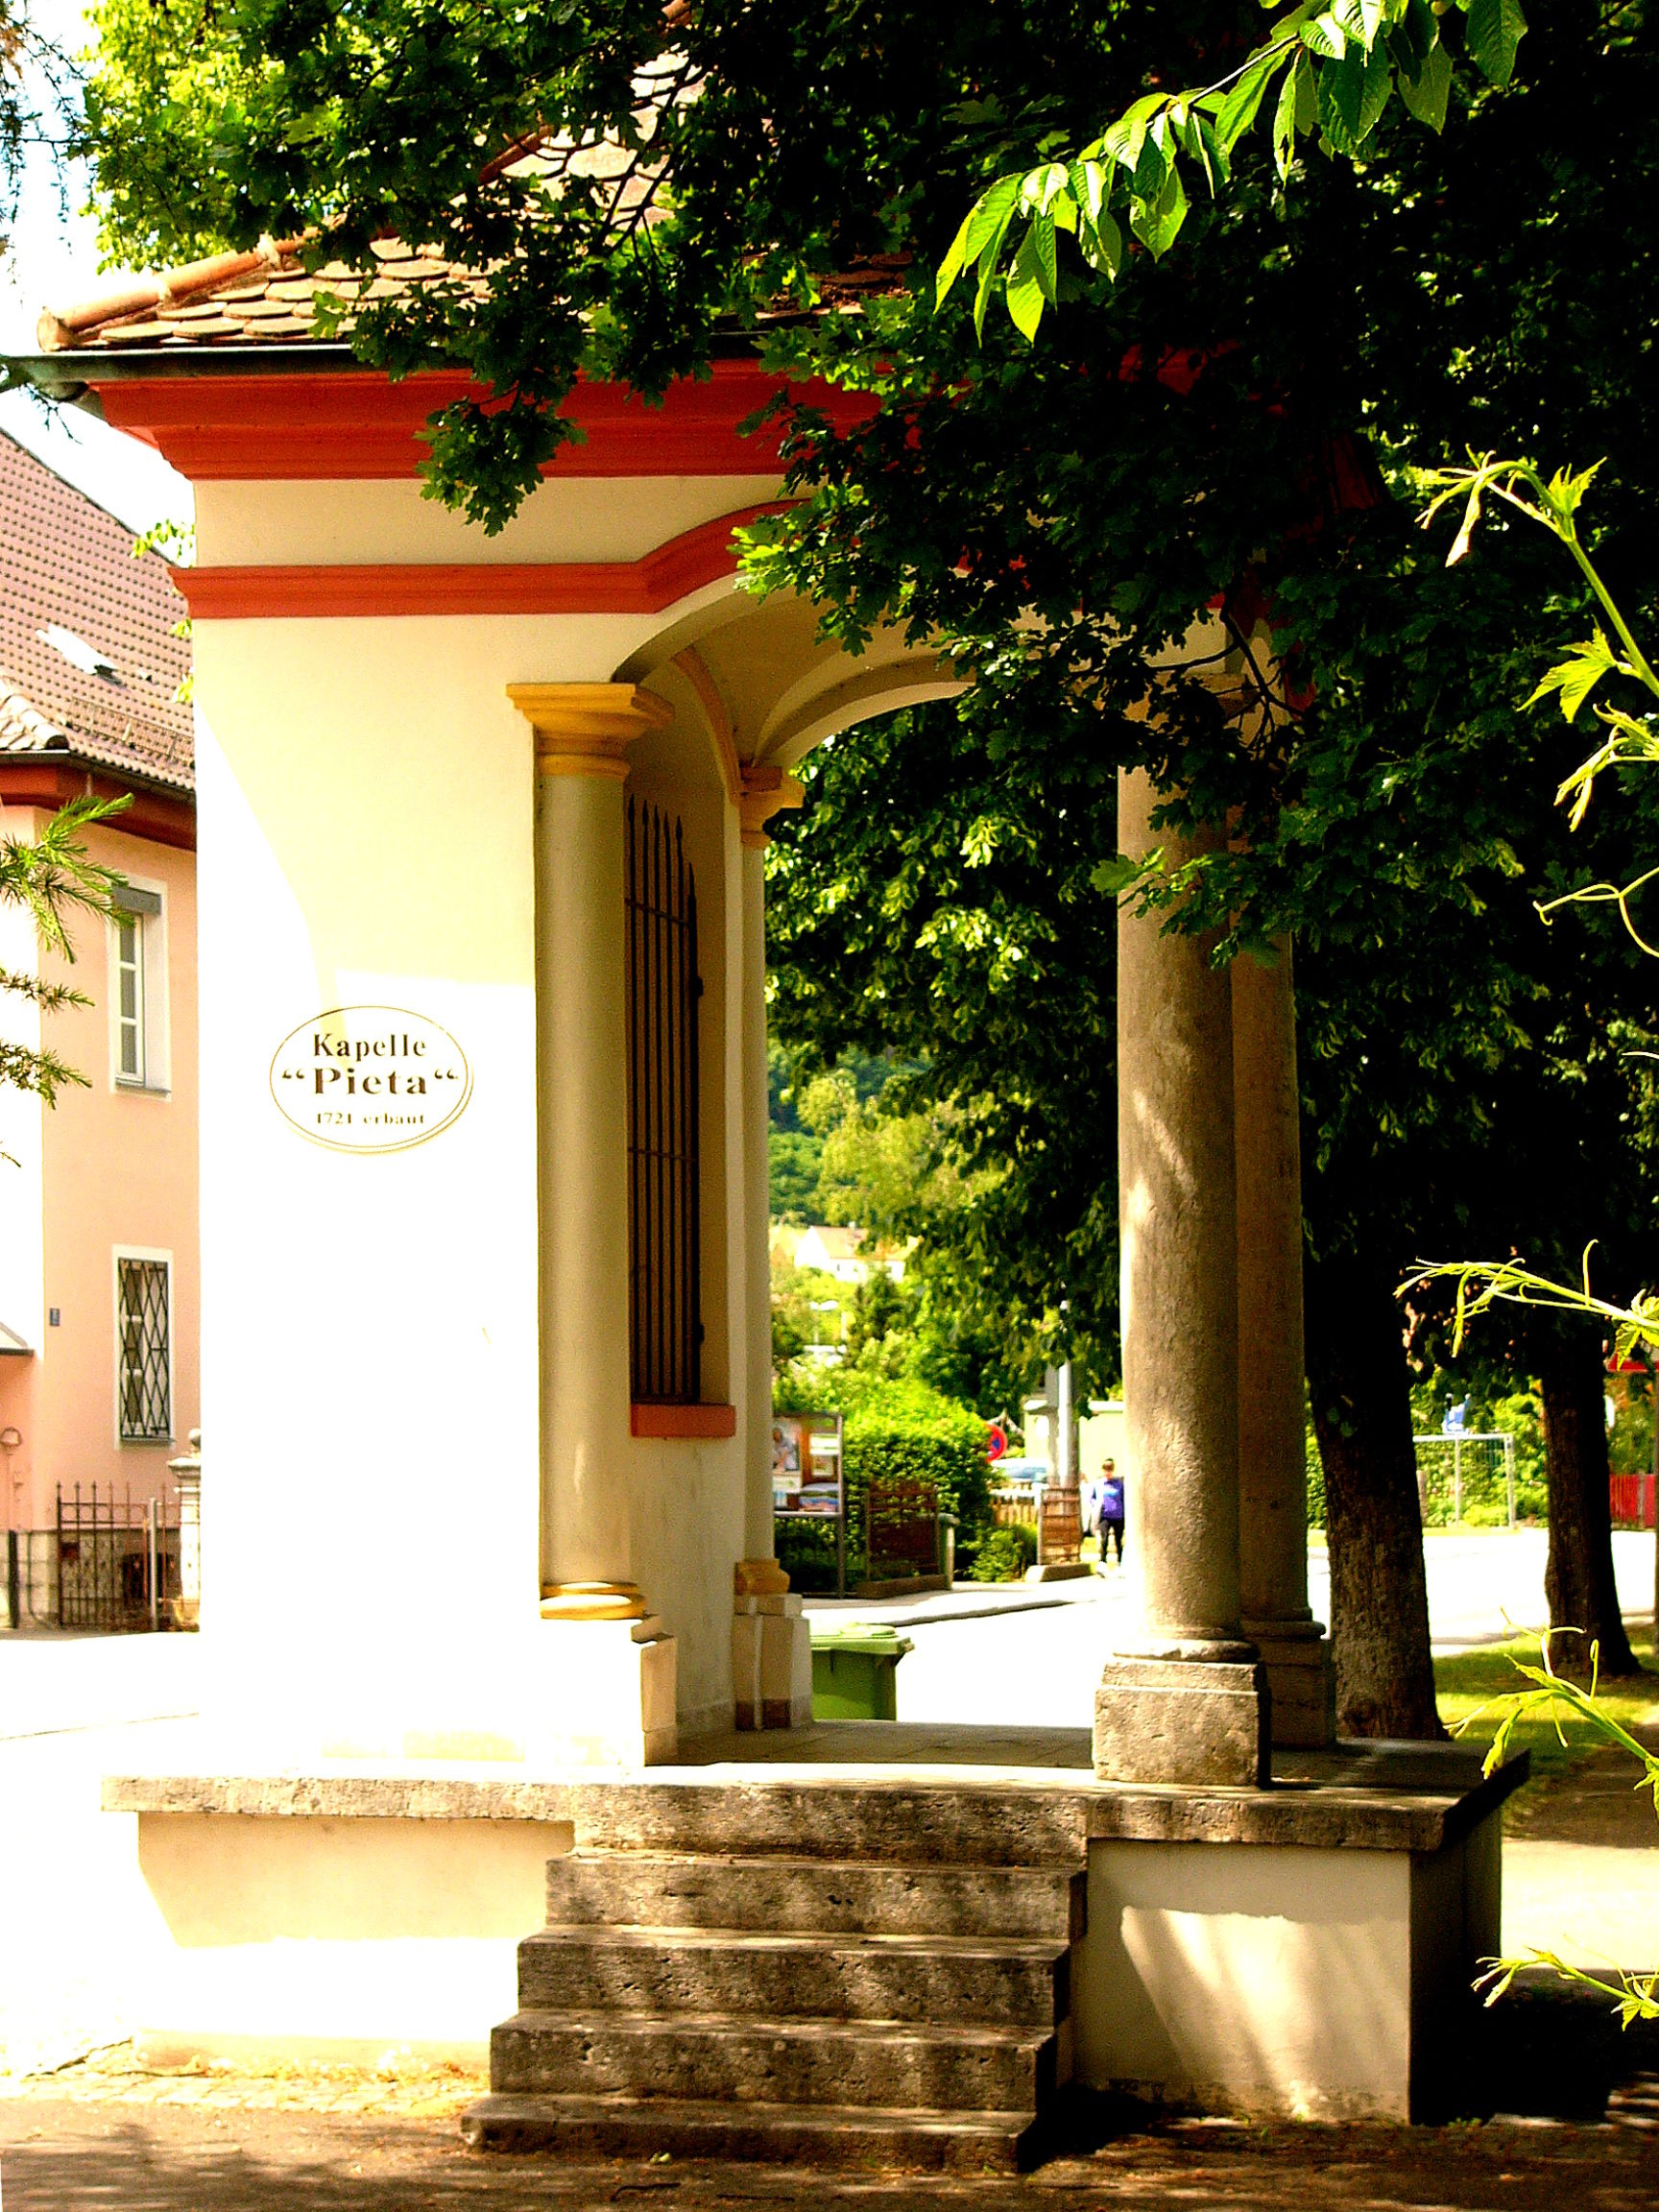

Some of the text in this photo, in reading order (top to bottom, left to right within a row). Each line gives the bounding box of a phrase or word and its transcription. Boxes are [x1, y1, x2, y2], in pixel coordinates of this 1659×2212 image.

[313, 1033, 426, 1062] Kapelle
[316, 1113, 425, 1124] 1721 erbaut
